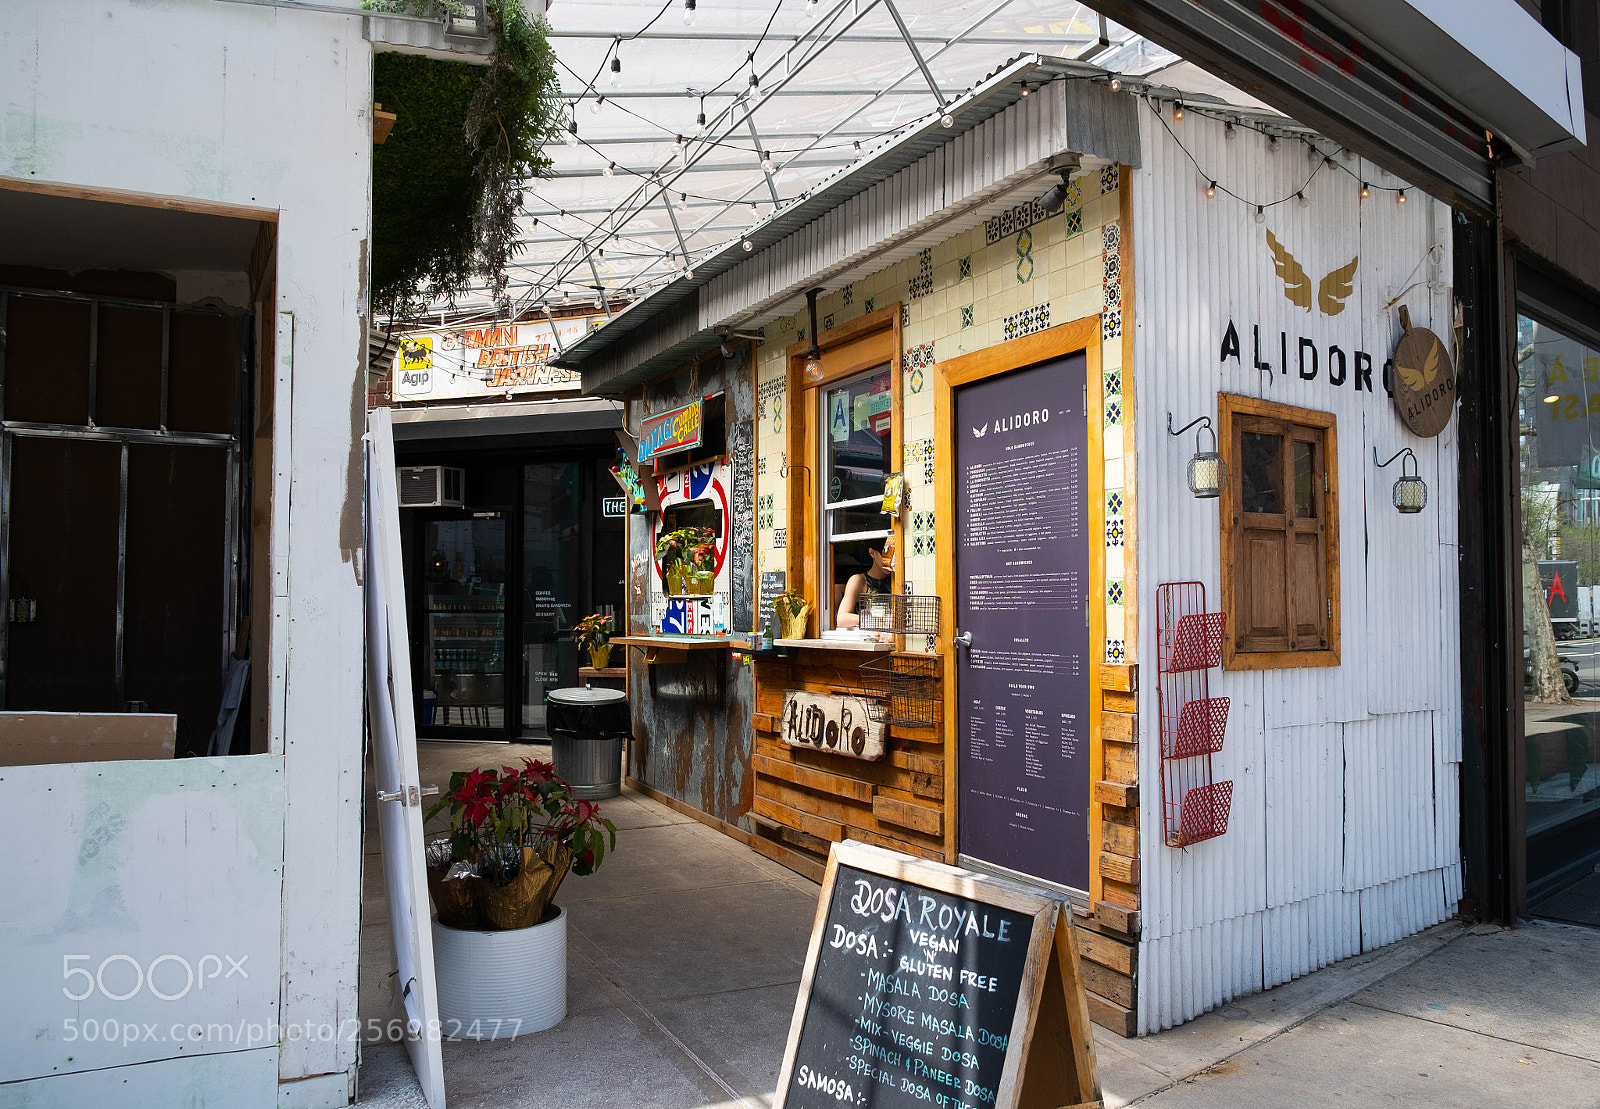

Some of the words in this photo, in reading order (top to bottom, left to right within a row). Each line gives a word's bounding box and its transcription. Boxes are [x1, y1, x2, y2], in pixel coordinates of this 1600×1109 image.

[477, 343, 550, 369] BRITISH
[1221, 318, 1394, 398] ALIDORO
[401, 370, 430, 387] Agip
[833, 398, 846, 429] A
[1407, 378, 1454, 420] ALIDORO
[677, 413, 699, 443] CALLE
[993, 408, 1049, 434] ALIDORO
[606, 501, 625, 513] THE
[850, 879, 911, 923] DOSA
[918, 895, 1012, 942] ROYALE
[909, 929, 960, 954] VEGAN
[899, 955, 953, 981] GLUTEN
[959, 969, 998, 992] FREE
[928, 985, 970, 1009] DOSA
[921, 1012, 975, 1042] MASALA
[978, 1028, 1008, 1052] DOSA
[941, 1047, 980, 1070] DOSA
[900, 1077, 931, 1101] DOSA
[936, 1092, 950, 1109] OF
[914, 1058, 961, 1089] PANEER
[964, 1079, 996, 1104] DOSA
